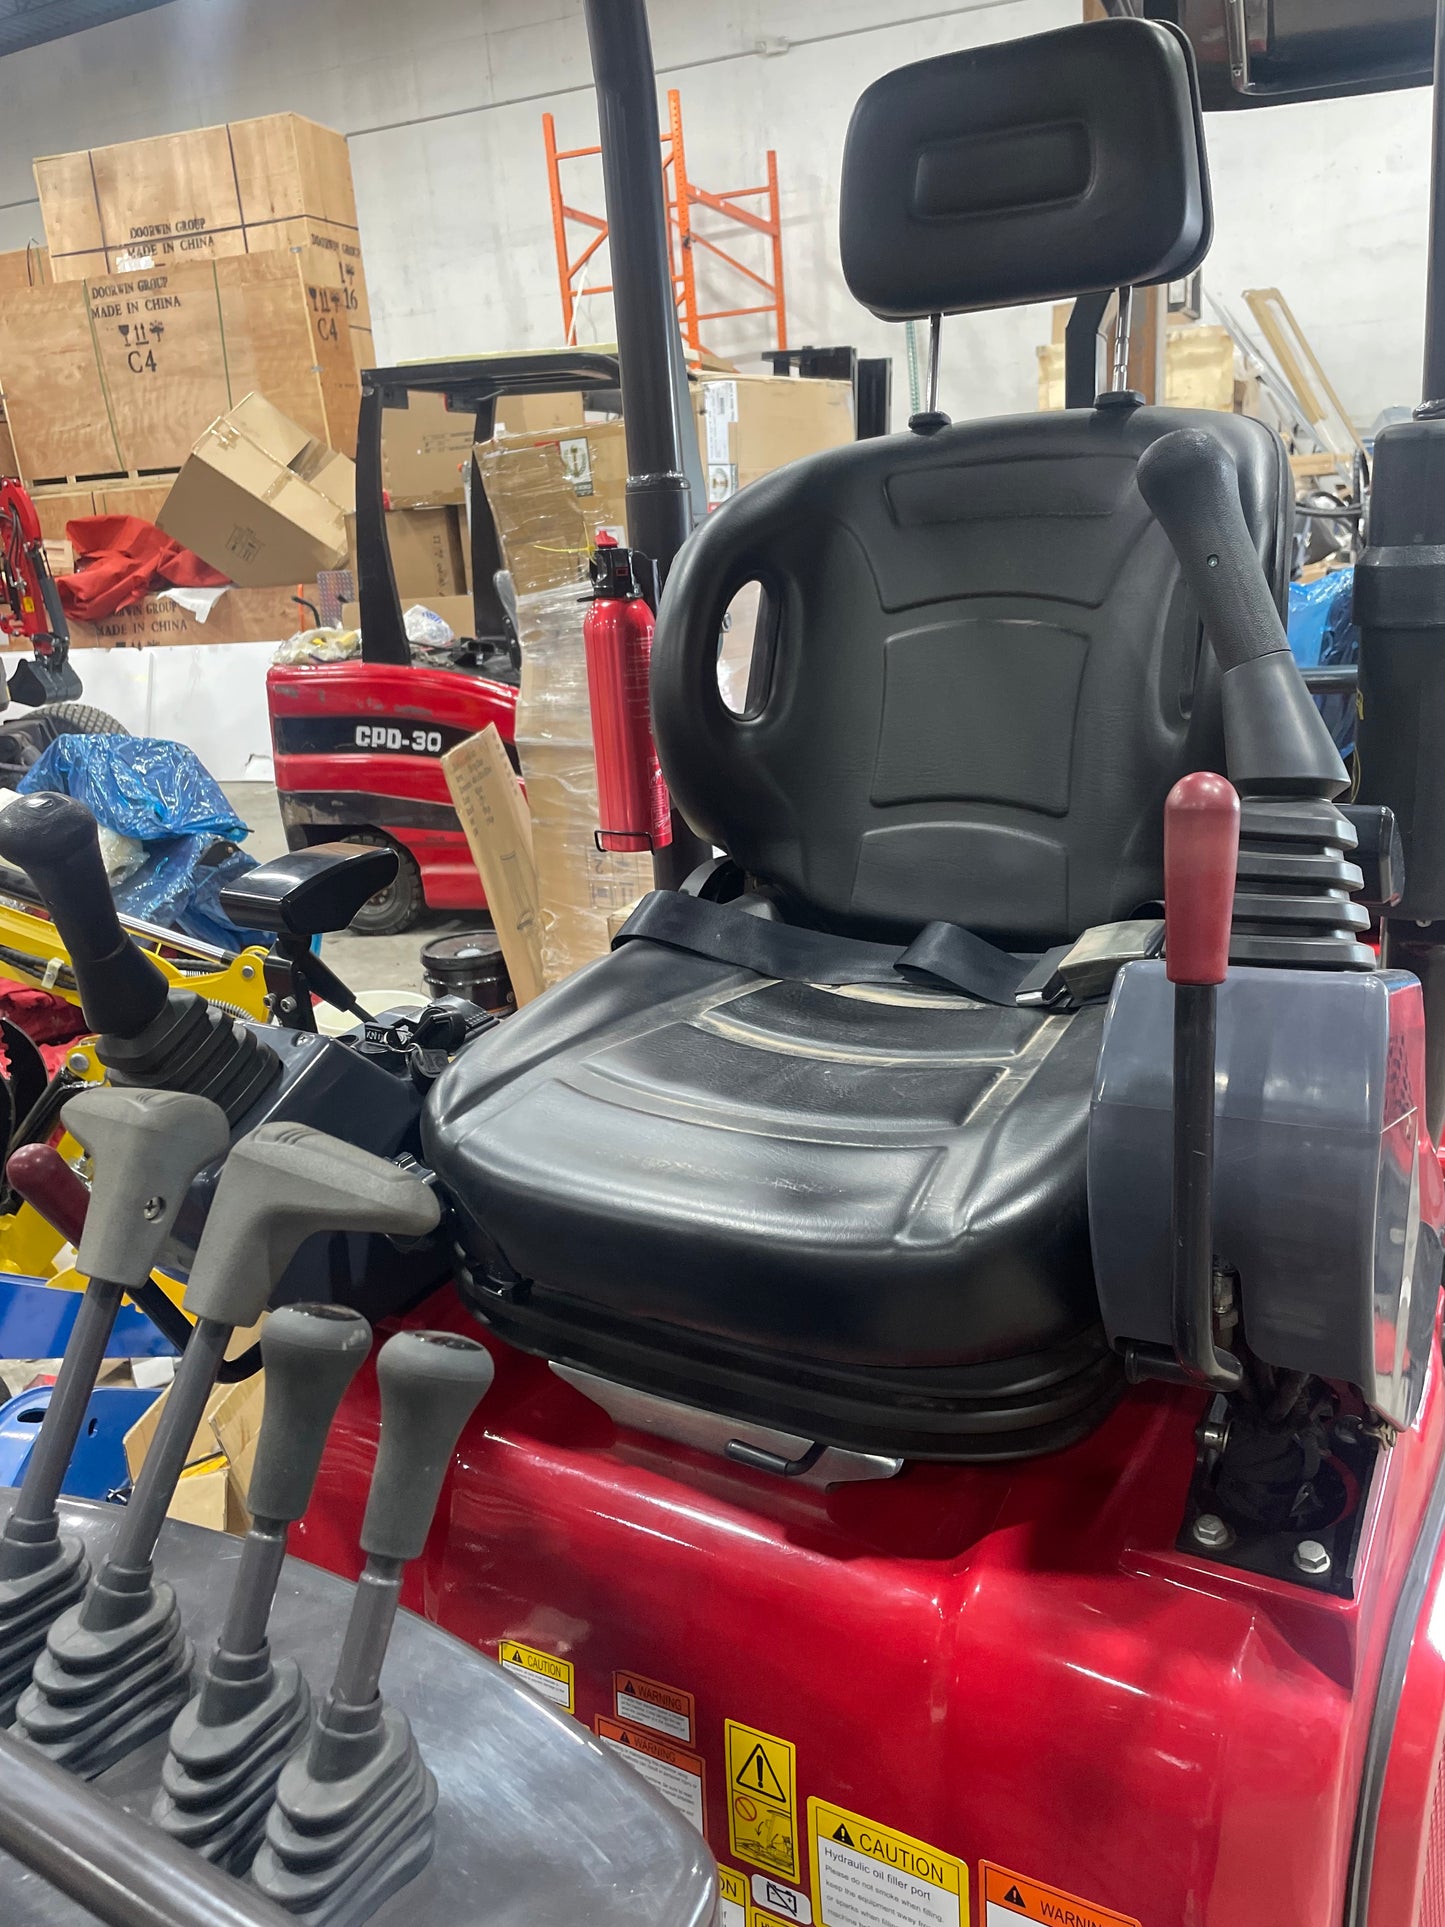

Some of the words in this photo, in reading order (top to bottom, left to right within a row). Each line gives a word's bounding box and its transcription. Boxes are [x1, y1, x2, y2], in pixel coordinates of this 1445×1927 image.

[130, 223, 171, 240] DOORWIN
[175, 218, 206, 233] GROUP
[128, 244, 158, 259] MADE
[163, 242, 175, 254] IN
[180, 235, 215, 251] CHINA
[92, 282, 134, 300] DOORWIN
[137, 276, 168, 292] GROUP
[344, 286, 358, 311] 16
[91, 304, 122, 320] MADE
[127, 301, 139, 314] IN
[145, 295, 181, 312] CHINA
[317, 316, 338, 342] C4
[127, 348, 157, 374] C4
[146, 600, 176, 614] GROUP
[95, 622, 127, 637] MADE
[133, 622, 145, 634] IN
[151, 618, 188, 633] CHINA
[355, 725, 442, 753] CPD-30
[527, 1655, 561, 1677] CAUTION
[637, 1684, 682, 1711] WARNING
[634, 1736, 676, 1763] WARNING
[859, 1833, 944, 1884] CAUTION
[824, 1847, 870, 1874] Hydraulic
[872, 1869, 884, 1880] oil
[887, 1873, 908, 1890] filler
[910, 1886, 931, 1901] port
